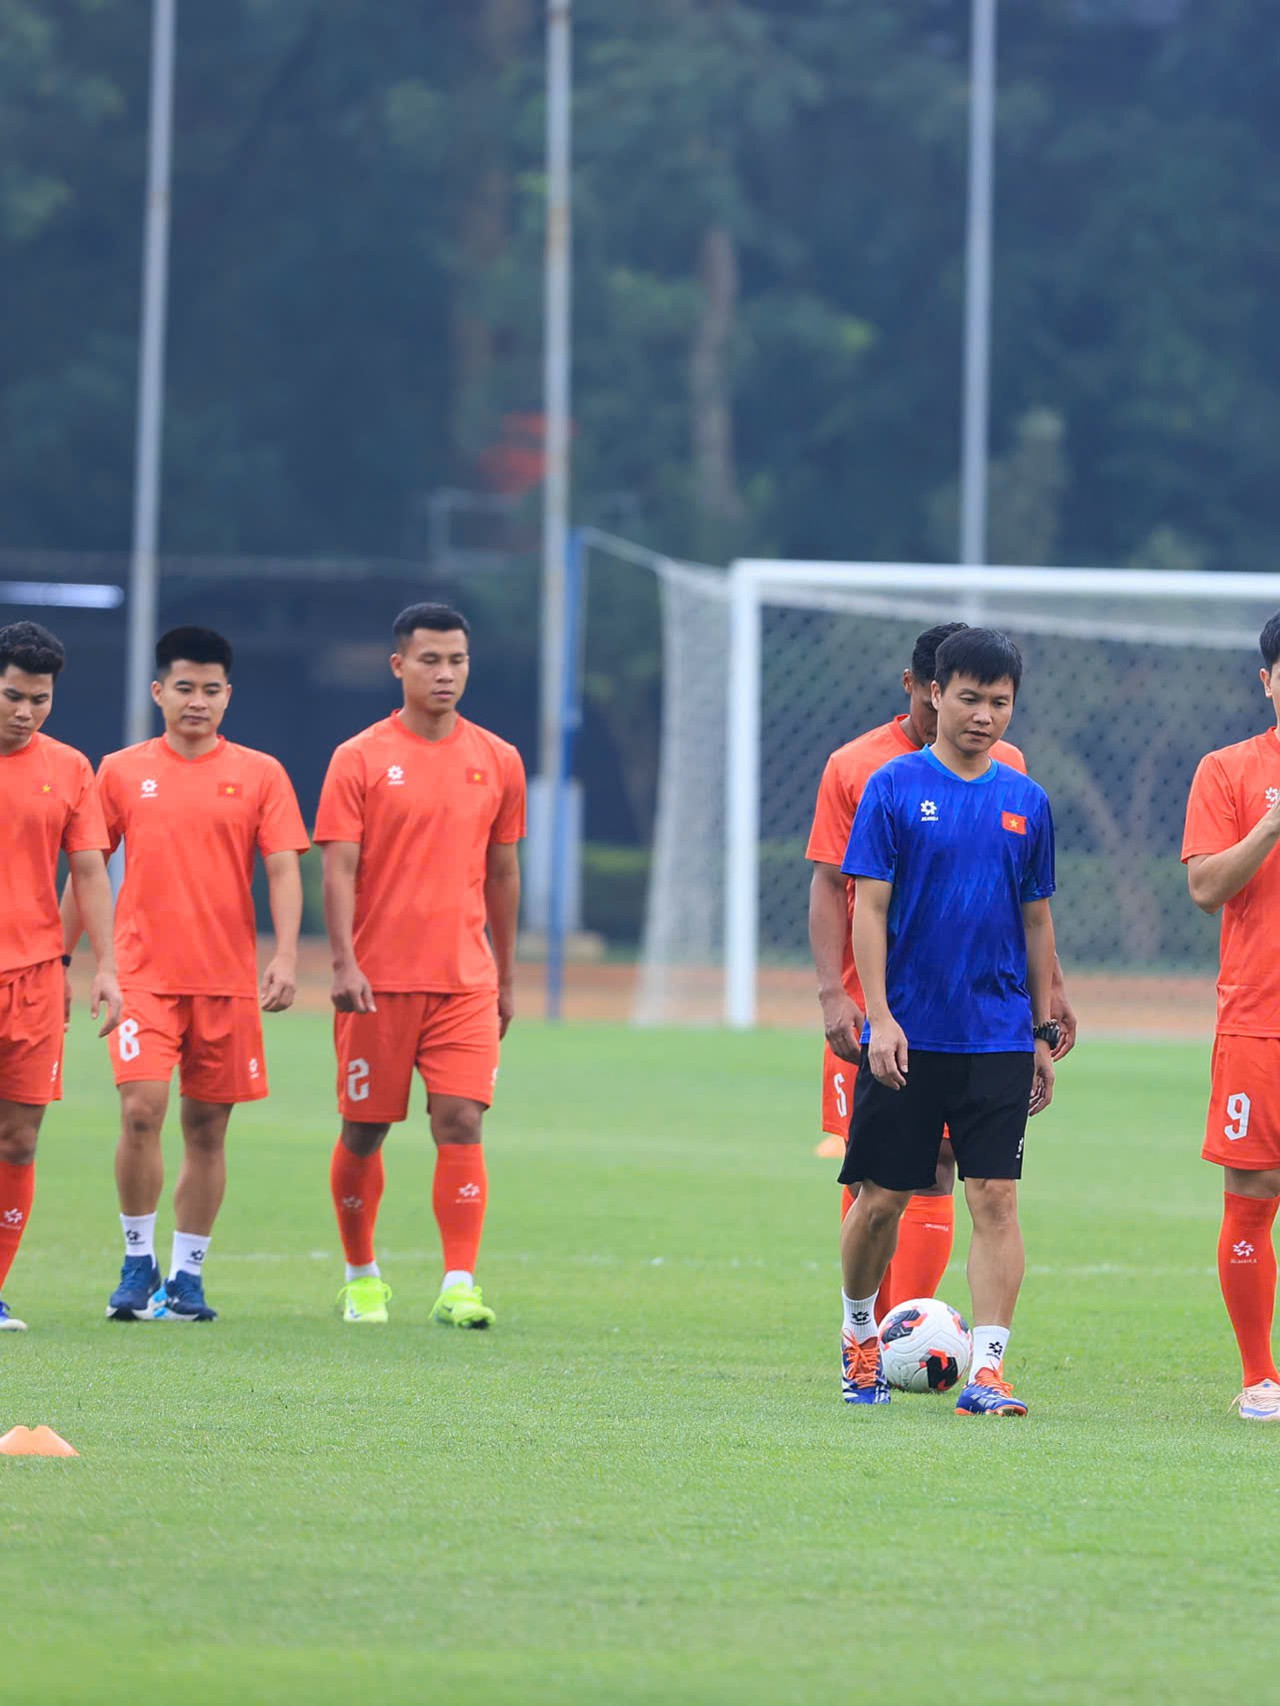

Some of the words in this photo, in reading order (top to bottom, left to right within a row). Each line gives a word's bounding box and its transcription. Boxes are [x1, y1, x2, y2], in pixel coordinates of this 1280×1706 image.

[118, 1018, 140, 1063] 8
[348, 1058, 369, 1102] 2
[833, 1072, 848, 1118] 5
[1224, 1092, 1251, 1141] 9
